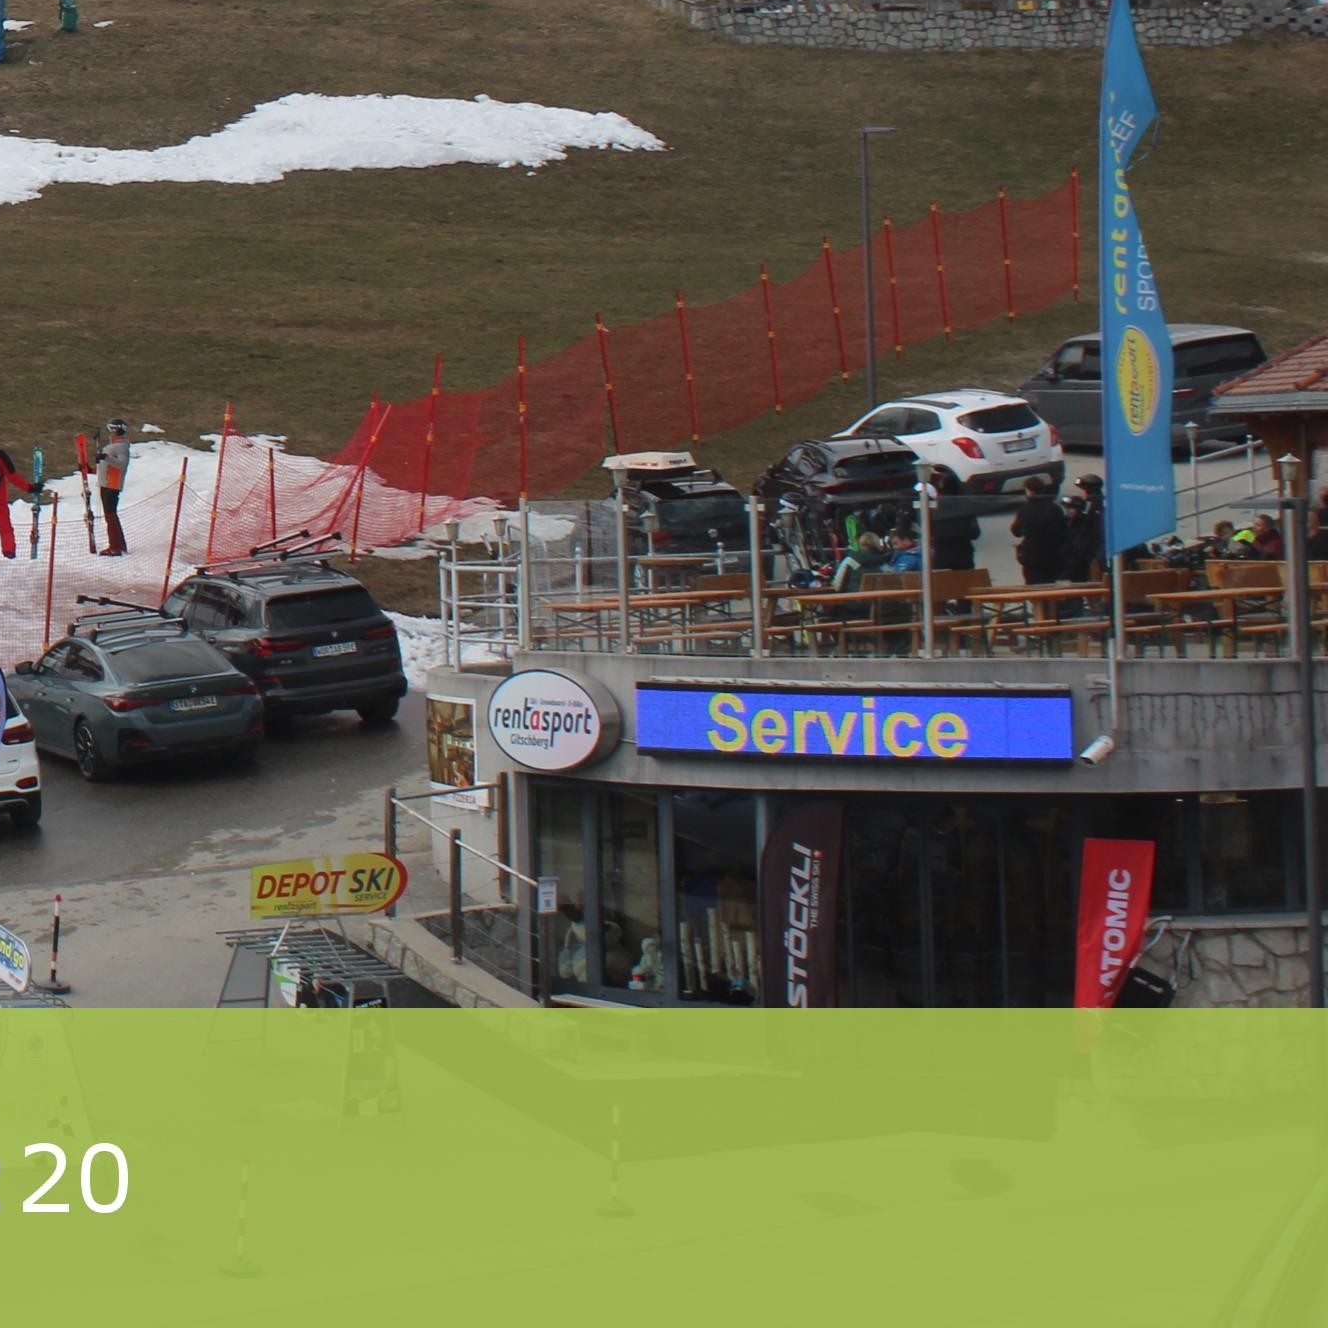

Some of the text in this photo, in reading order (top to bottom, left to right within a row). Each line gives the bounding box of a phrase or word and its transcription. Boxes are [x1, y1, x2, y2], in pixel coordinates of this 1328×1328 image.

[1110, 229, 1129, 315] rent
[494, 697, 592, 747] rentasport
[510, 733, 549, 750] Gitschberg
[708, 692, 968, 758] Service
[257, 867, 395, 900] DEPOT SKI
[354, 892, 388, 903] SERVICE
[784, 841, 812, 1008] STÖCKLI
[1099, 869, 1132, 987] ATOMIC
[12, 952, 24, 969] go
